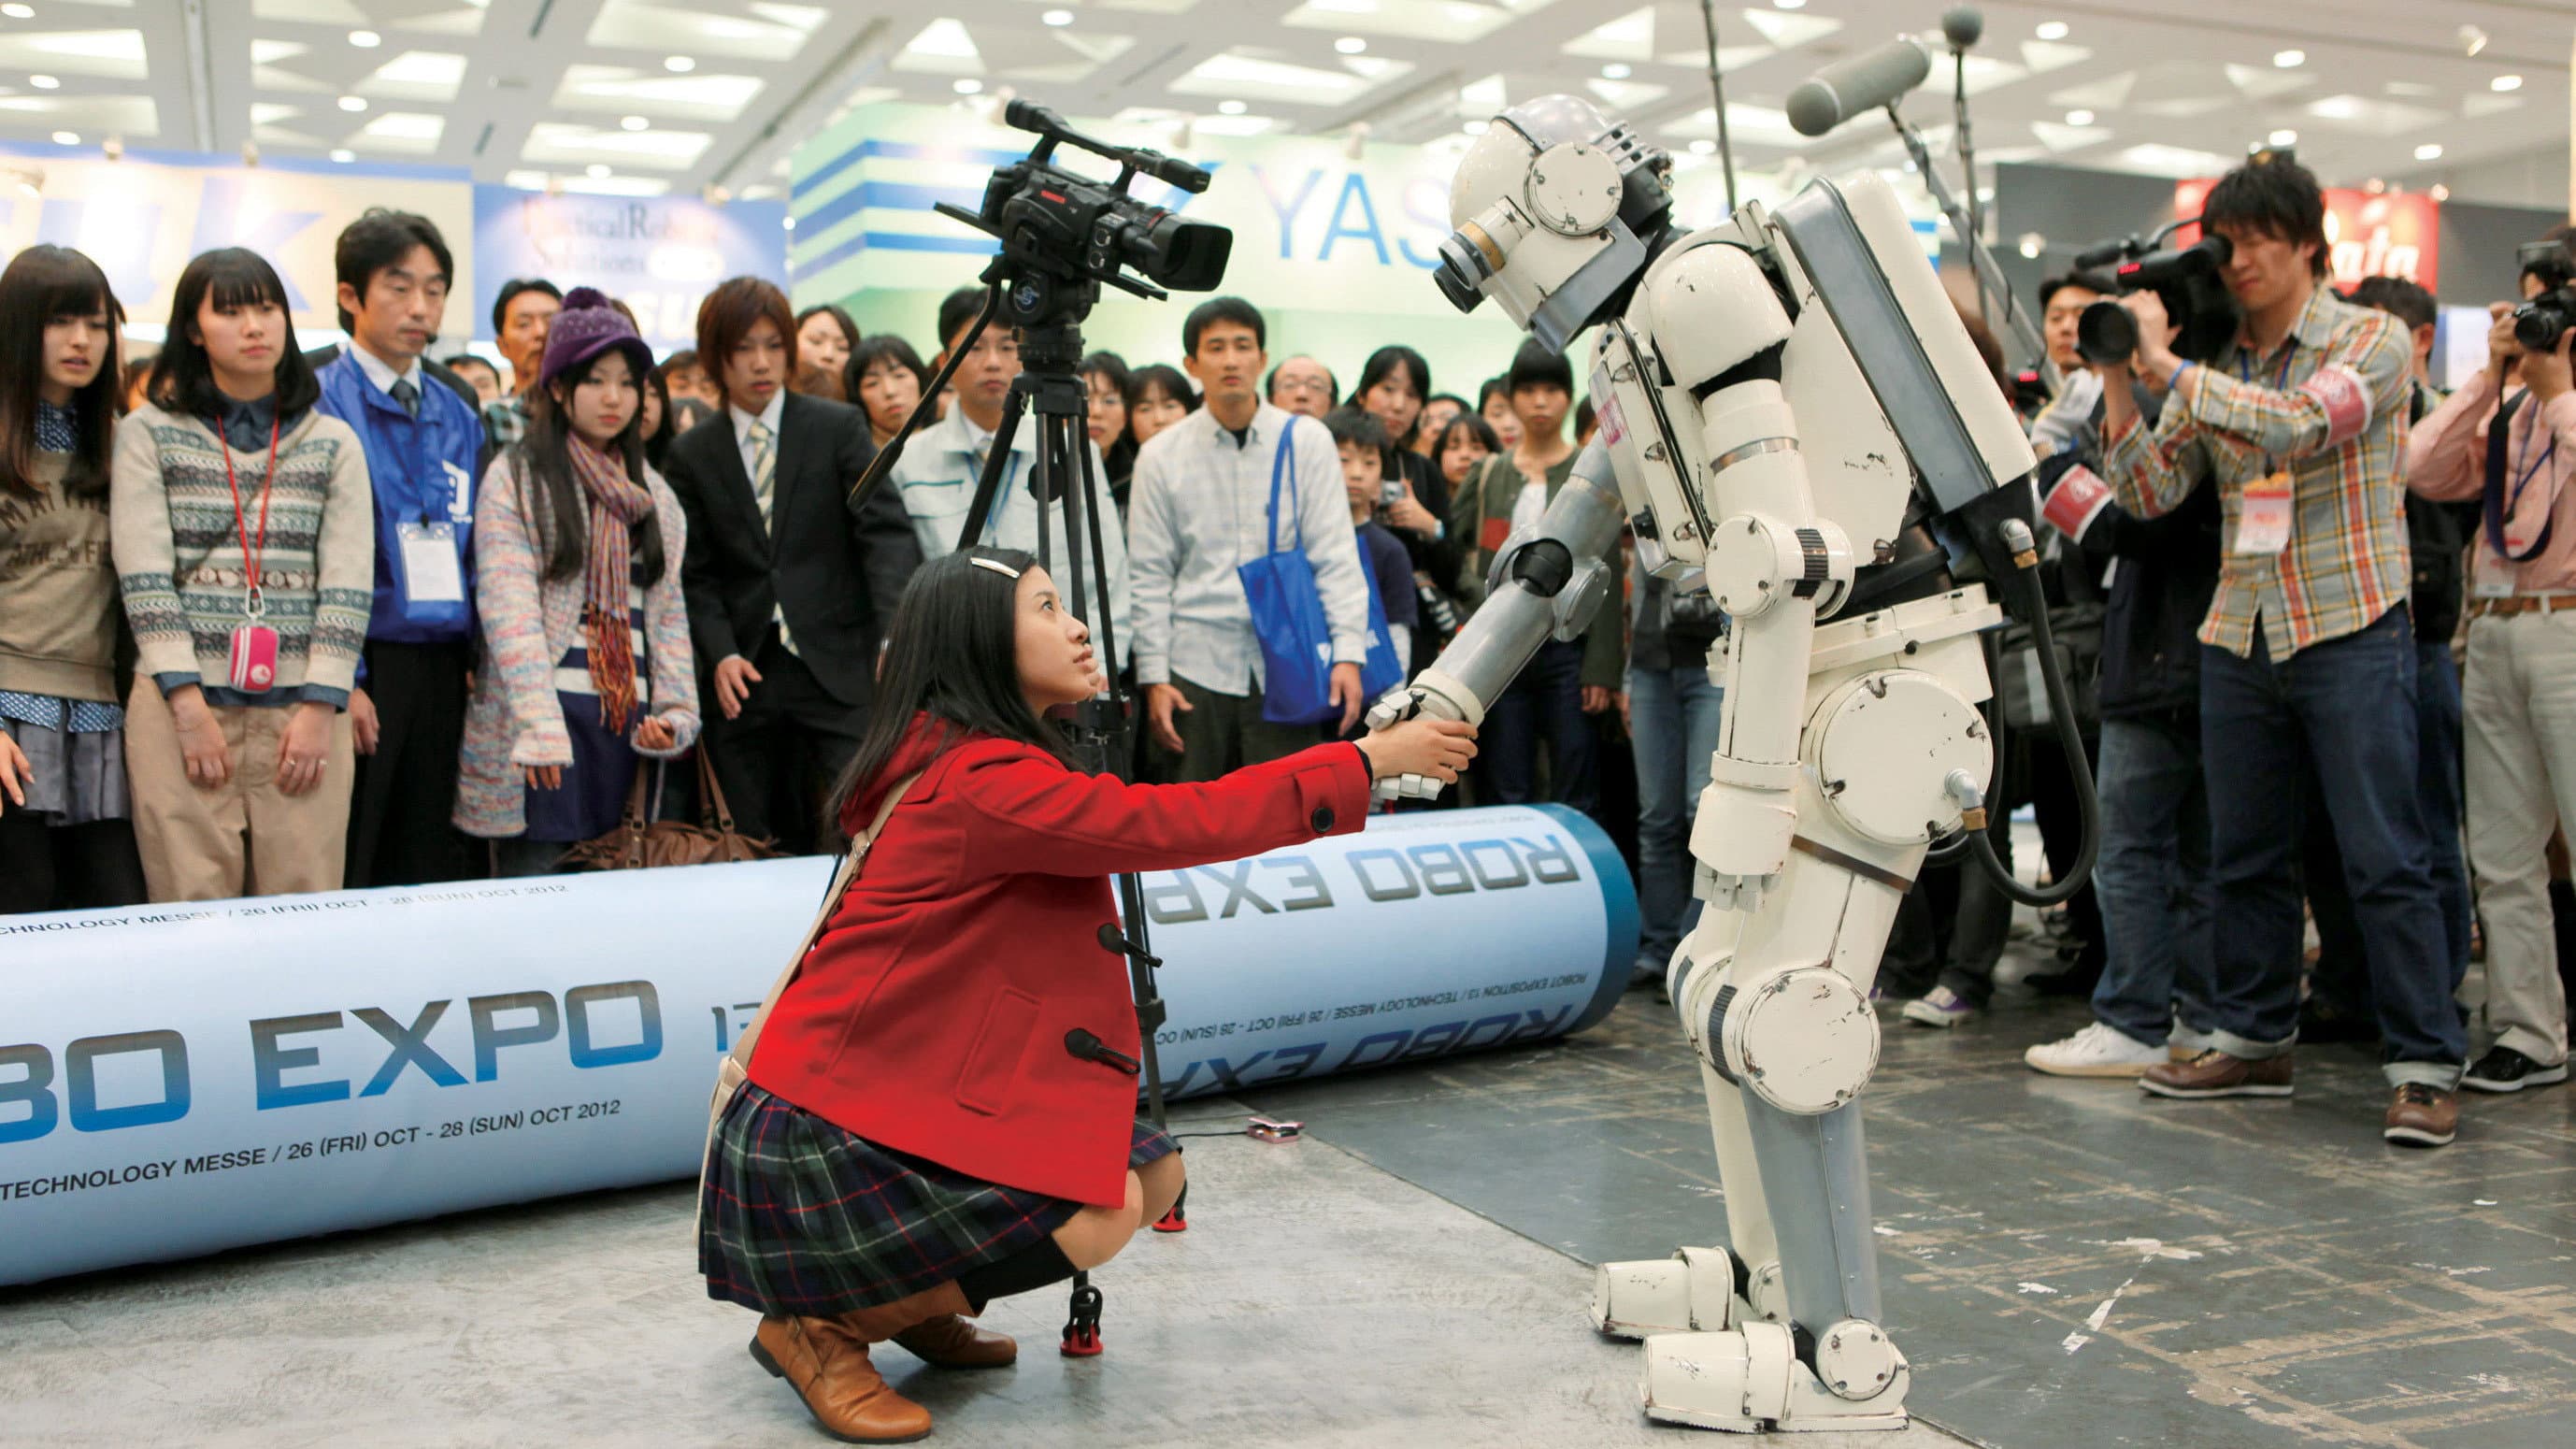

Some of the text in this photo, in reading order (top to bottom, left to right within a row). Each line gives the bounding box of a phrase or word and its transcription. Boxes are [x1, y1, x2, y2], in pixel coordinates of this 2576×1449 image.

[1111, 834, 1581, 928] ROBO EXP
[139, 911, 217, 924] MESSE
[325, 899, 367, 911] OCT
[249, 979, 664, 1111] EXPO
[1155, 1031, 1178, 1045] OC
[1247, 1017, 1275, 1032] OCT
[0, 1160, 178, 1201] TECHNOLOGY
[184, 1147, 266, 1175] MESSE
[287, 1141, 313, 1161] 26
[321, 1132, 367, 1156] (FRI)
[374, 1126, 421, 1148] OCT
[439, 1121, 464, 1139] 28
[469, 1110, 523, 1136] (SUN)
[530, 1106, 573, 1126] OCT
[578, 1099, 622, 1119] 2012
